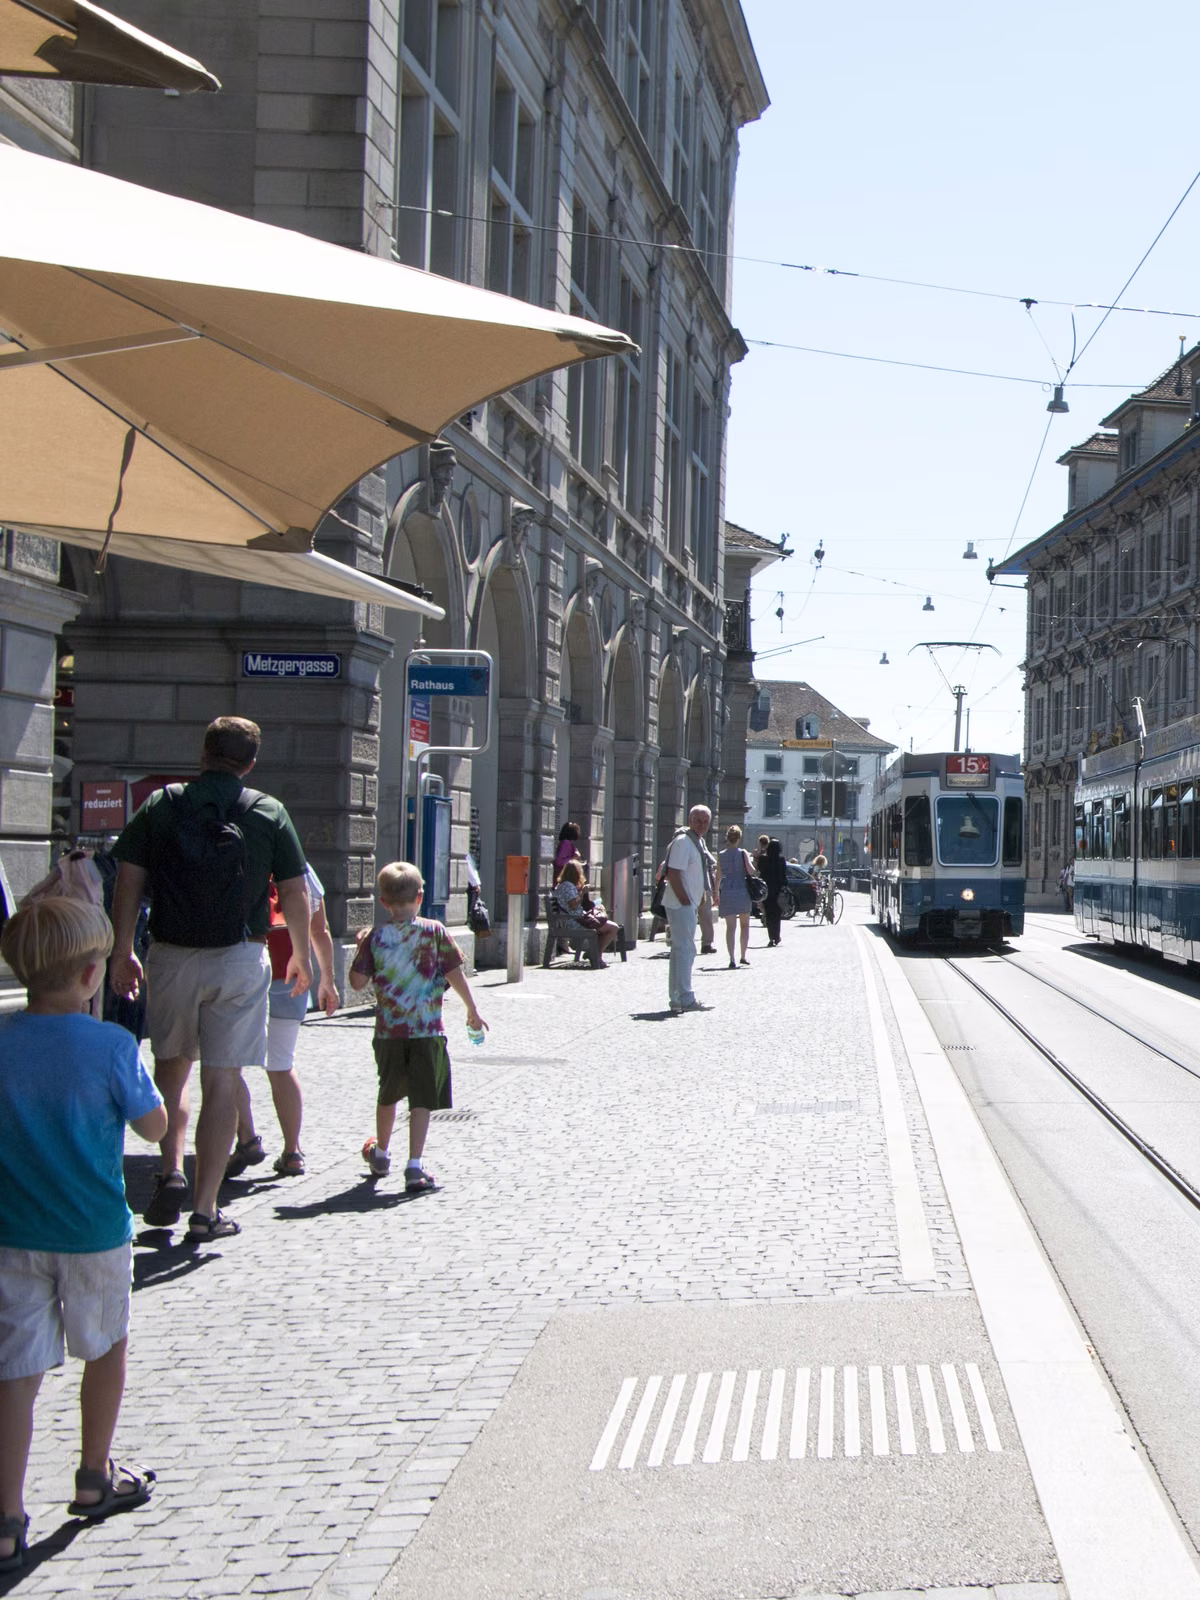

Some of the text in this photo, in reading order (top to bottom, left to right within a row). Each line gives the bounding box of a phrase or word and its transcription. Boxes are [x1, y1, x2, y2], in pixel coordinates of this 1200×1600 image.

[247, 655, 335, 676] Metzgergasse
[410, 679, 455, 690] Rathaus
[957, 756, 979, 773] 15
[84, 796, 123, 809] reduziert
